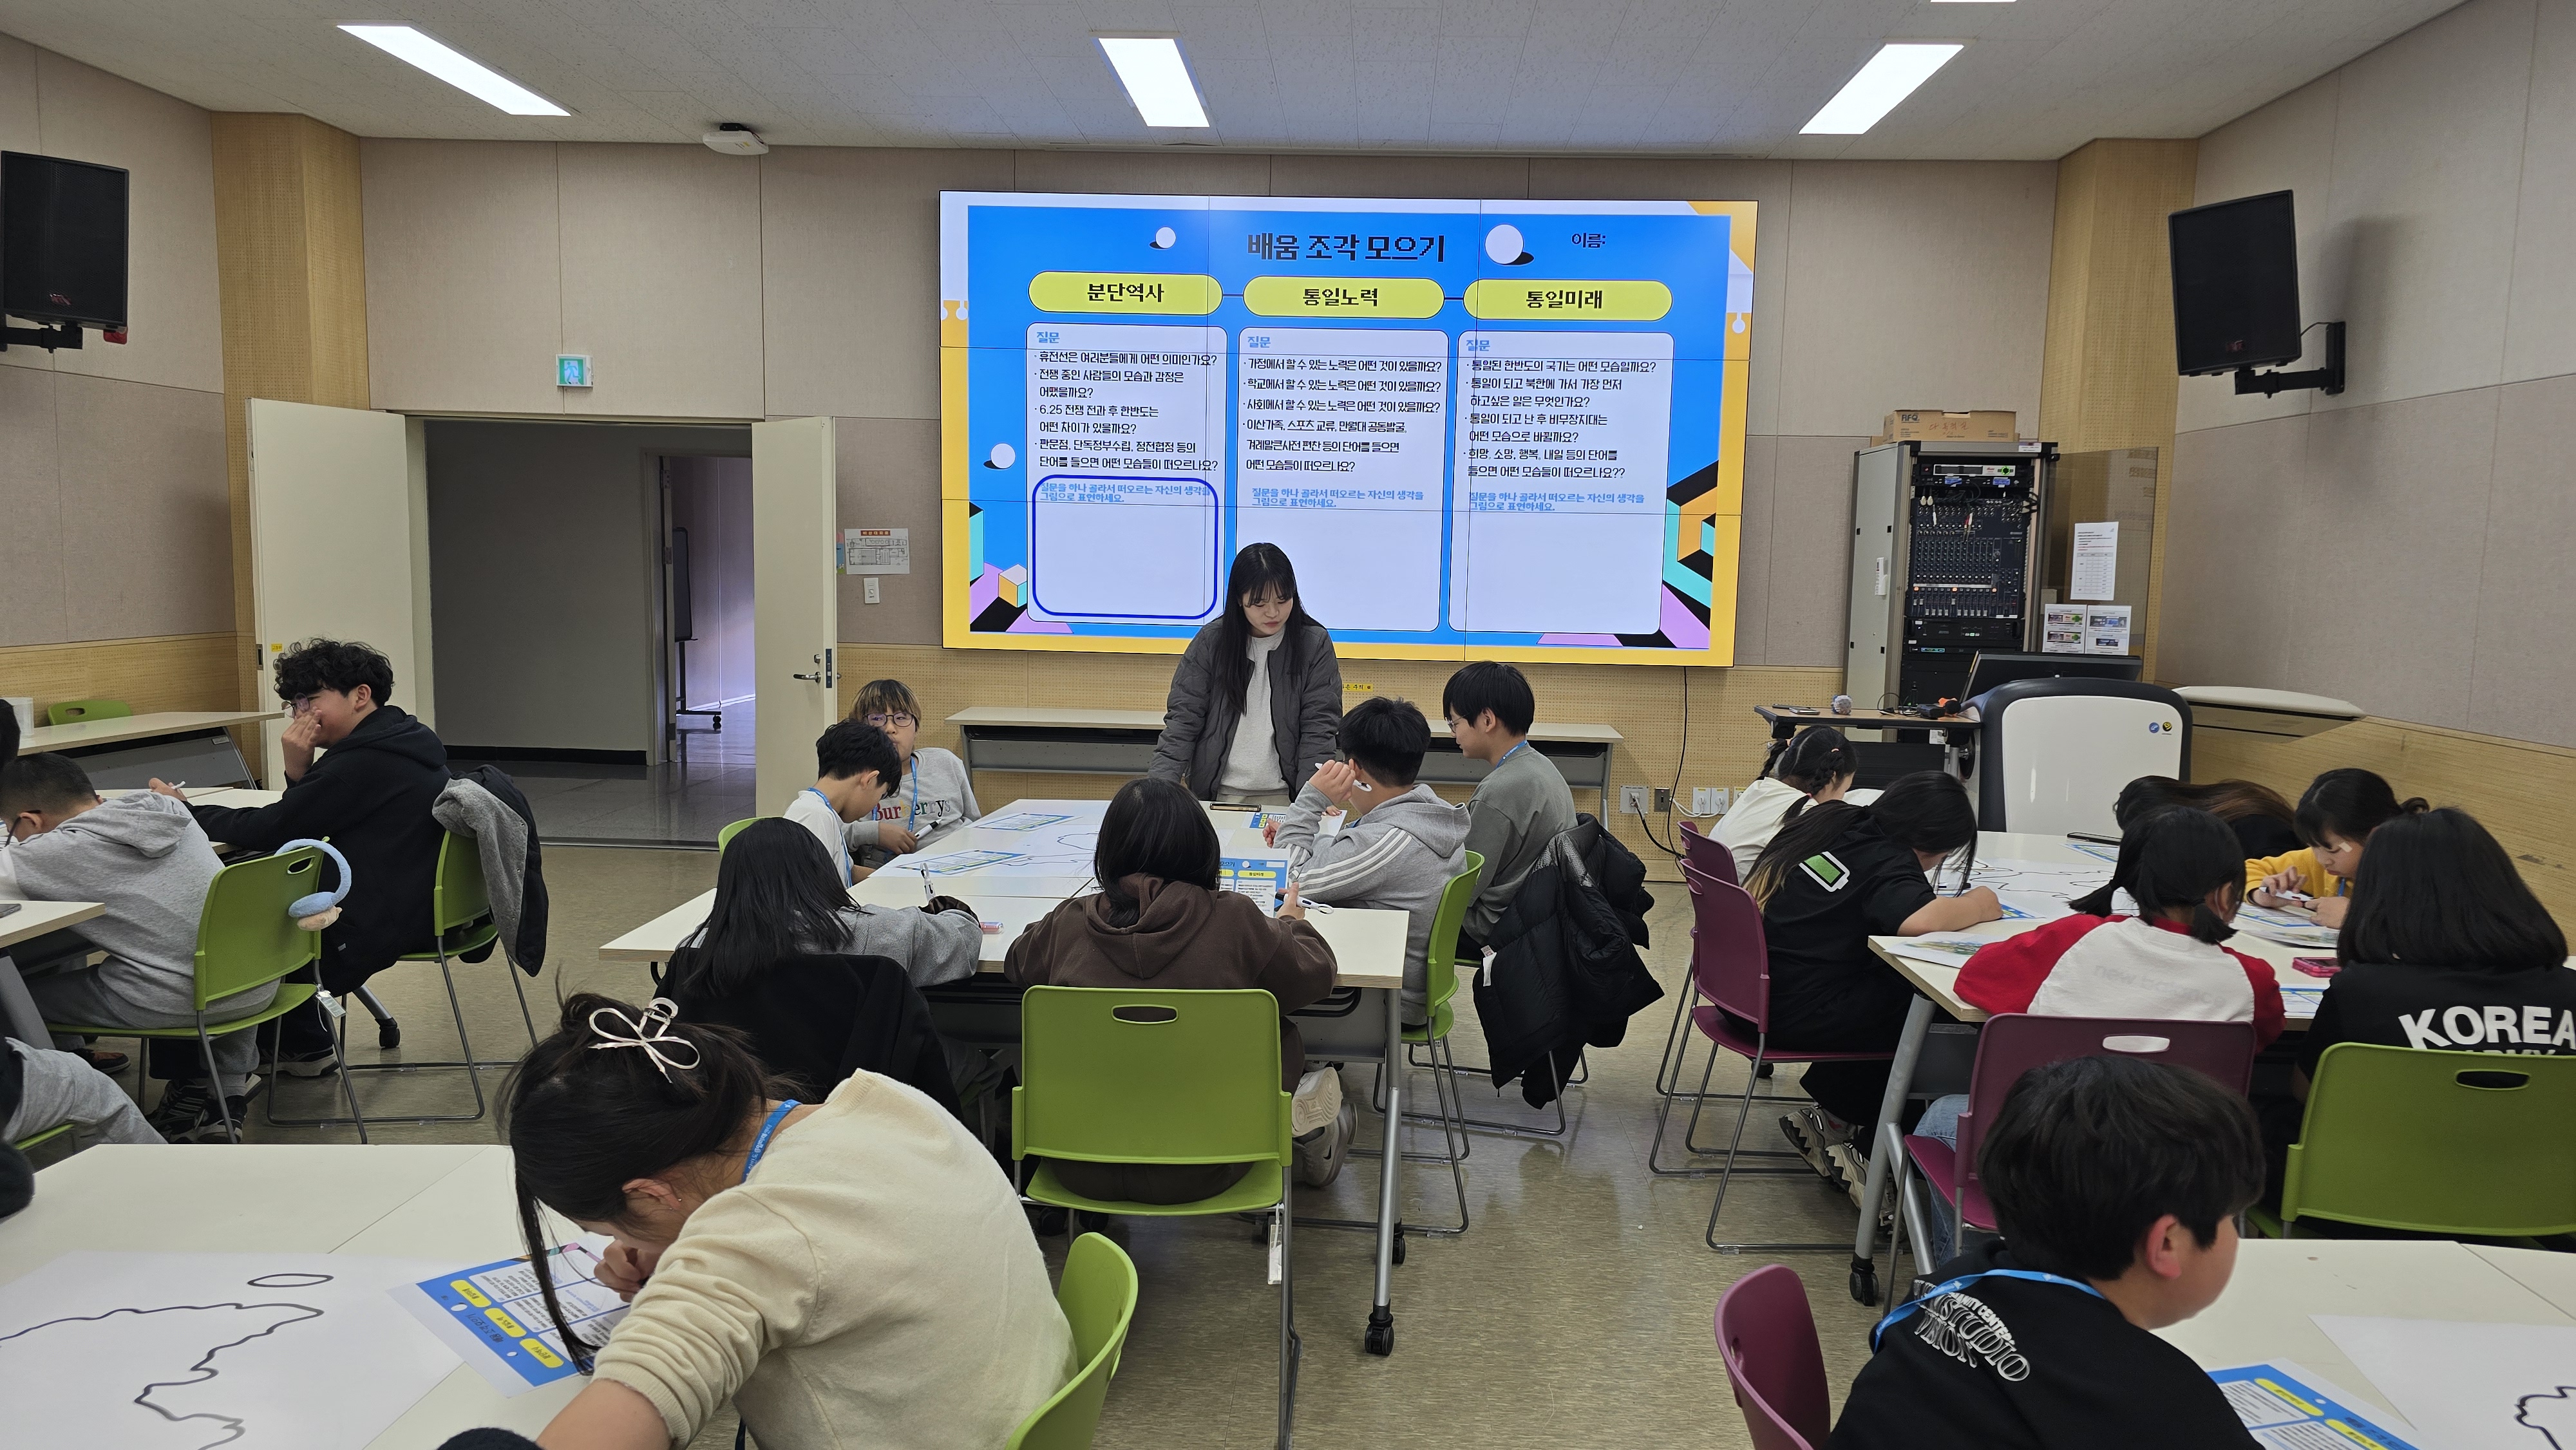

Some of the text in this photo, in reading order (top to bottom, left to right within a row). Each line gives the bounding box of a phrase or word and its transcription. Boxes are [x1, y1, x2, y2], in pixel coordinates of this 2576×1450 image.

[1571, 231, 1606, 249] 이름:
[1247, 232, 1444, 263] 배움 조각 모으기
[1086, 282, 1165, 304] 분단역사
[1303, 287, 1379, 308] 통일노력
[1526, 290, 1603, 310] 통일미래
[1037, 332, 1059, 343] 질문
[1247, 337, 1271, 348] 질문
[1466, 340, 1490, 351] 질문
[1039, 351, 1217, 365] 휴전선은 여러분들에게 어떤 의미인가요?
[1249, 359, 1441, 372] 가정에서 할 수 있는 노력은 어떤 것이 있을까요?
[1472, 361, 1656, 372] 통일된 한반도의 국기는 어떤 모습일까요?
[1040, 370, 1184, 382] 전쟁 중인 사람들의 모습과 감정은
[1247, 379, 1441, 392] 학교에서 할 수 있는 노력은 어떤 것이 있을까요?
[1472, 378, 1622, 390] 통일이 되고 북한에 가서 가장 먼저
[1040, 387, 1093, 398] 어땠을까요?
[1247, 399, 1440, 413] 사회에서 할 수 있는 노력은 어떤 것이 있을까요?
[1471, 395, 1589, 408] 하고싶은 일은 무엇인가요?
[1040, 405, 1159, 417] 6.25 전쟁 전과 후 한반도는
[1470, 413, 1607, 426] 통일이 되고 난 후 비무장지대는
[1040, 422, 1136, 434] 어떤 차이가 있을까요?
[1470, 431, 1578, 443] 어떤 모습으로 바뀔까요?
[1040, 439, 1195, 453] 판문점, 단독정부수립, 정전협정 등의
[1247, 440, 1399, 453] 겨레말큰사전 편찬 등의 단어를 들으면
[1040, 457, 1218, 471] 단어를 들으면 어떤 모습들이 떠오르나요?
[1246, 460, 1354, 471] 어떤 모습들이 떠오르나요?
[1468, 466, 1625, 478] 들으면 어떤 모습들이 떠오르나요??
[1041, 484, 1066, 492] 질문을
[1069, 484, 1086, 492] 하나
[1118, 485, 1153, 494] 떠오르는
[1155, 485, 1181, 494] 자신의
[1252, 489, 1279, 497] 질문을
[1282, 489, 1298, 498] 하나
[1330, 490, 1365, 499] 떠오르는
[1368, 490, 1394, 499] 자신의
[1397, 491, 1423, 500] 생각을
[1040, 493, 1124, 502] 그림으로 표현하세요.
[1252, 498, 1336, 507] 그림으로 표현하세요.
[1470, 492, 1496, 501] 질문을
[1499, 493, 1517, 502] 하나
[1549, 494, 1585, 502] 떠오르는
[1587, 494, 1614, 503] 자신의
[1618, 494, 1644, 503] 생각을
[1470, 502, 1555, 511] 그림으로 표현하세요.
[2398, 1006, 2576, 1050] KOREA
[1940, 1298, 2031, 1382] STUDIO
